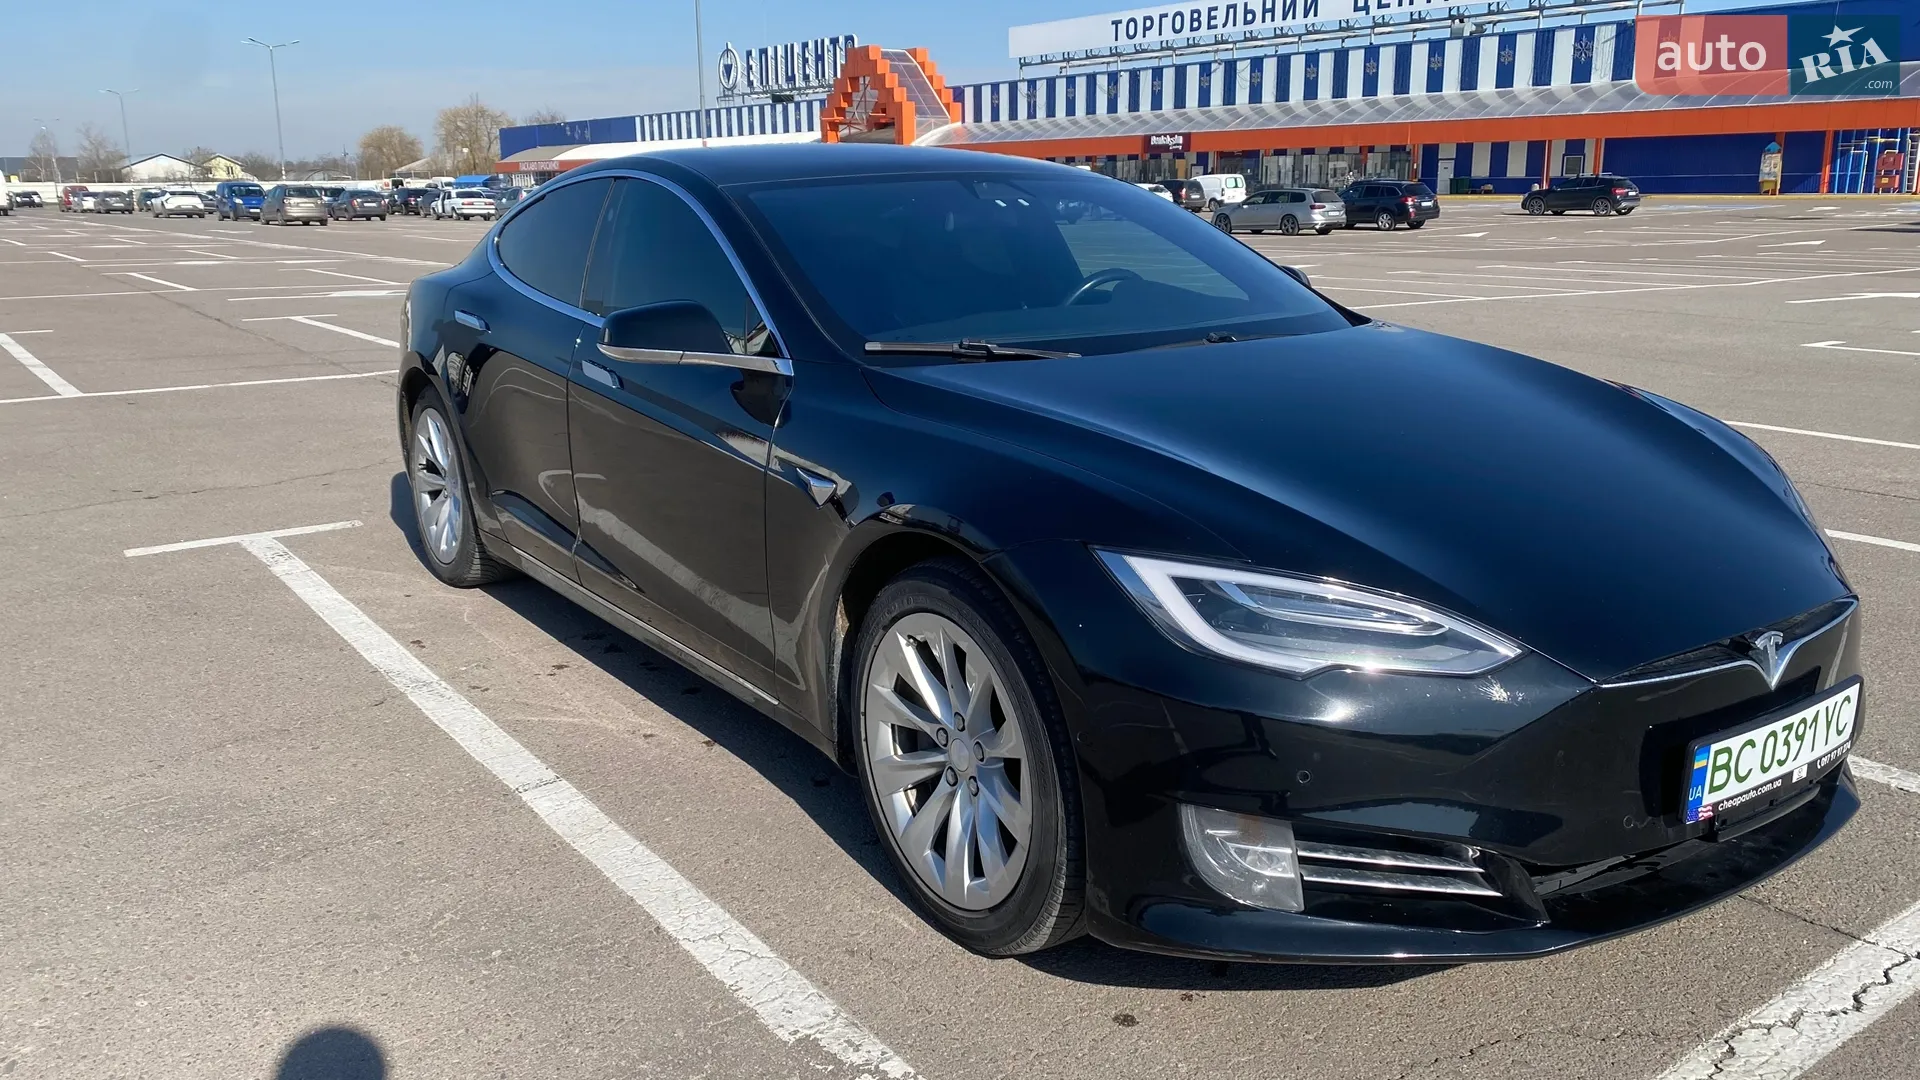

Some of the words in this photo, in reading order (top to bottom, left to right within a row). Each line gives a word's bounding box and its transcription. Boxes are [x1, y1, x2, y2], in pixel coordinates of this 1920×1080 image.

[1708, 738, 1757, 794] BC
[1760, 710, 1820, 774] 0391
[1824, 694, 1852, 746] YC
[1688, 785, 1702, 801] UA
[1718, 778, 1782, 812] cheapauto.com.ua
